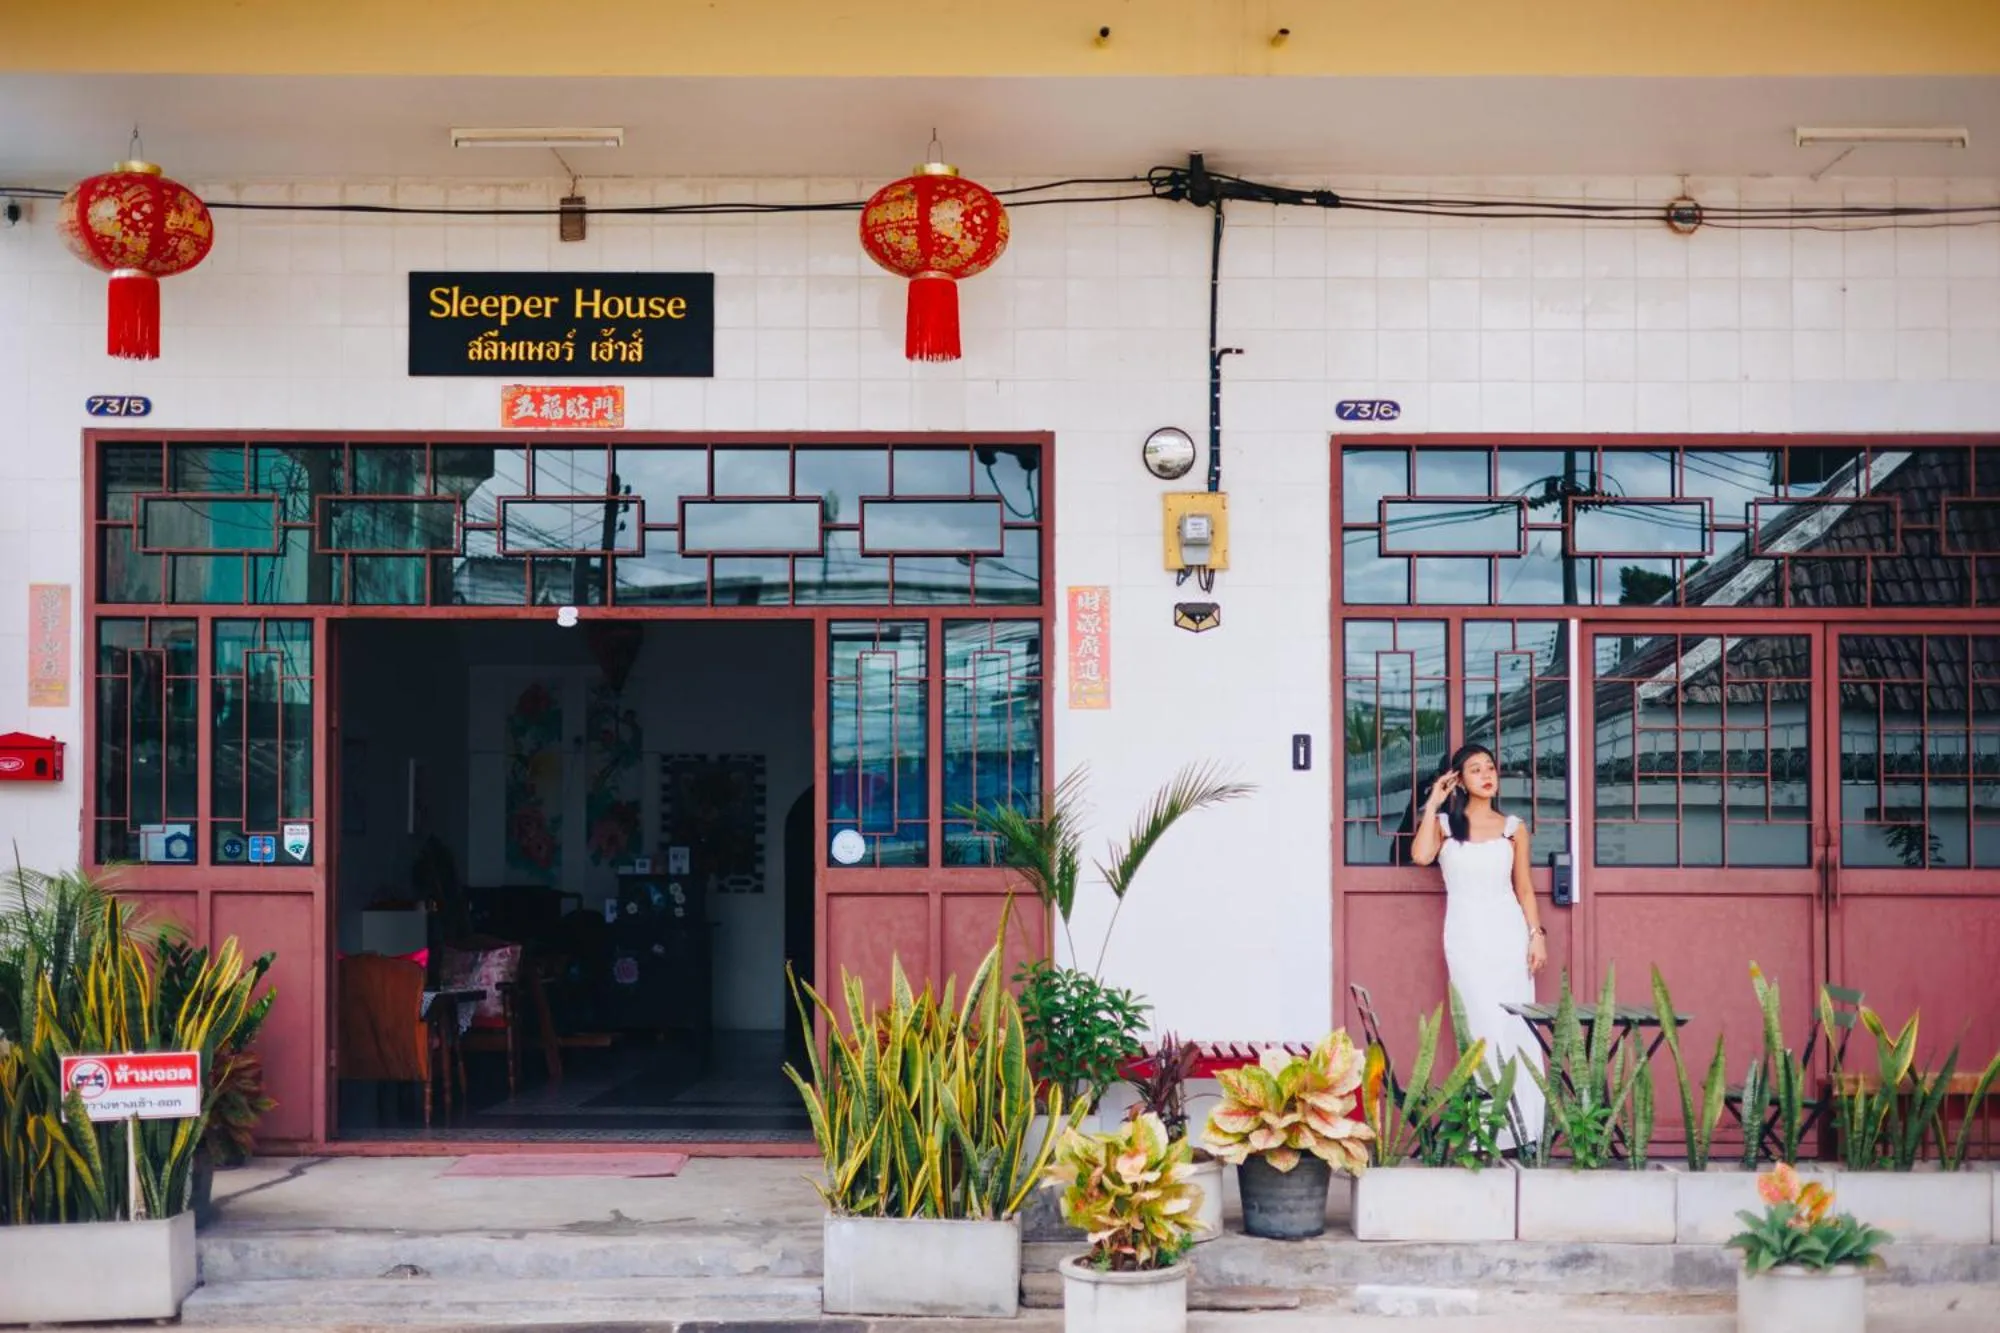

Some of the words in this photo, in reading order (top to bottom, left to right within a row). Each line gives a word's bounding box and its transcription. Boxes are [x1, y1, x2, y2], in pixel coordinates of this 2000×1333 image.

[429, 285, 559, 326] Sleeper
[574, 288, 687, 319] House
[468, 328, 577, 362] สลีพเพอร์
[591, 327, 643, 362] เฮ้าส์
[90, 397, 145, 417] 73/5
[512, 393, 615, 420] 五福臨門
[1342, 401, 1394, 421] 73/6
[114, 1064, 193, 1084] ห้ามจอด
